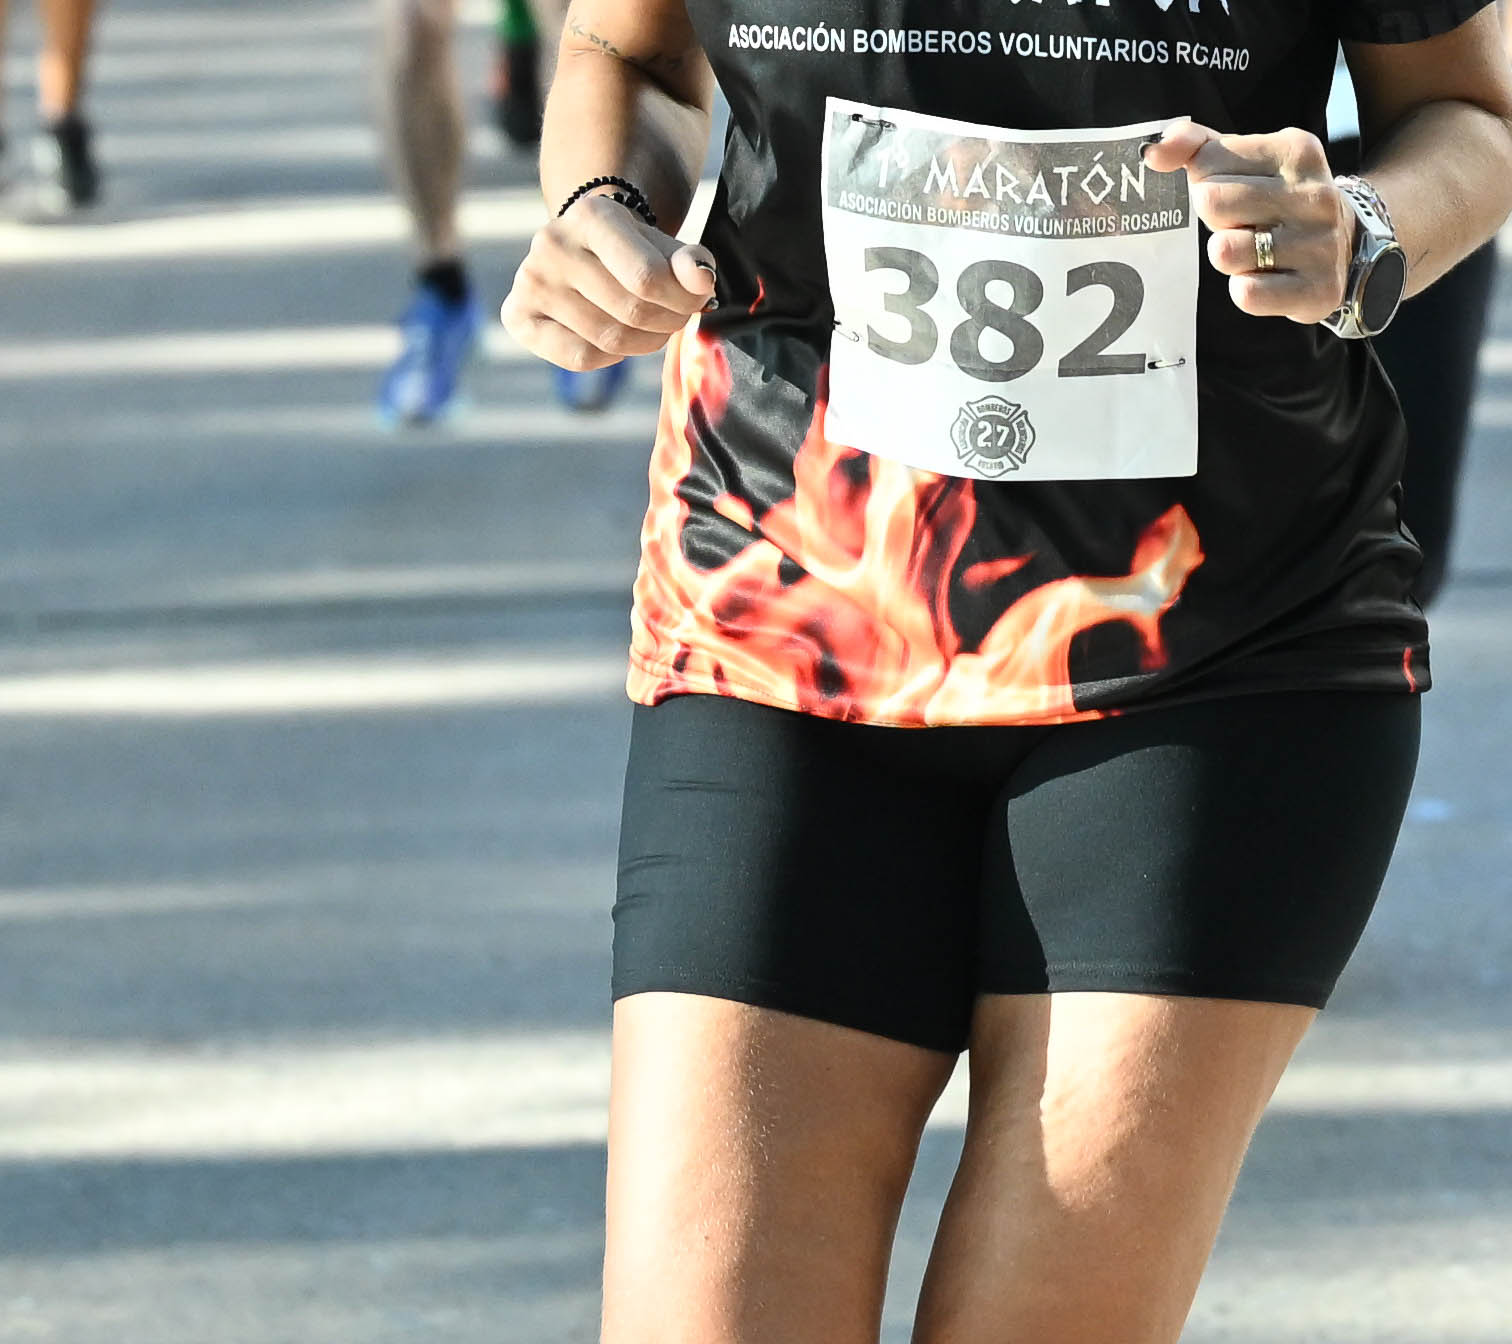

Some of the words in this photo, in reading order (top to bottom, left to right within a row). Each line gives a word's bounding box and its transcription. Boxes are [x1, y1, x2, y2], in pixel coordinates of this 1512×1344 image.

[728, 21, 845, 52] ASOCIACIÓN
[853, 28, 992, 54] BOMBEROS
[999, 31, 1169, 63] VOLUNTARIOS
[923, 151, 1145, 209] MARATÓN
[839, 189, 923, 222] ASOCIACIÓN
[927, 205, 1009, 232] BOMBEROS
[1014, 213, 1116, 237] VOLUNTARIOS
[1120, 208, 1184, 232] ROSARIO
[864, 246, 1147, 383] 382
[976, 419, 1010, 448] 27
